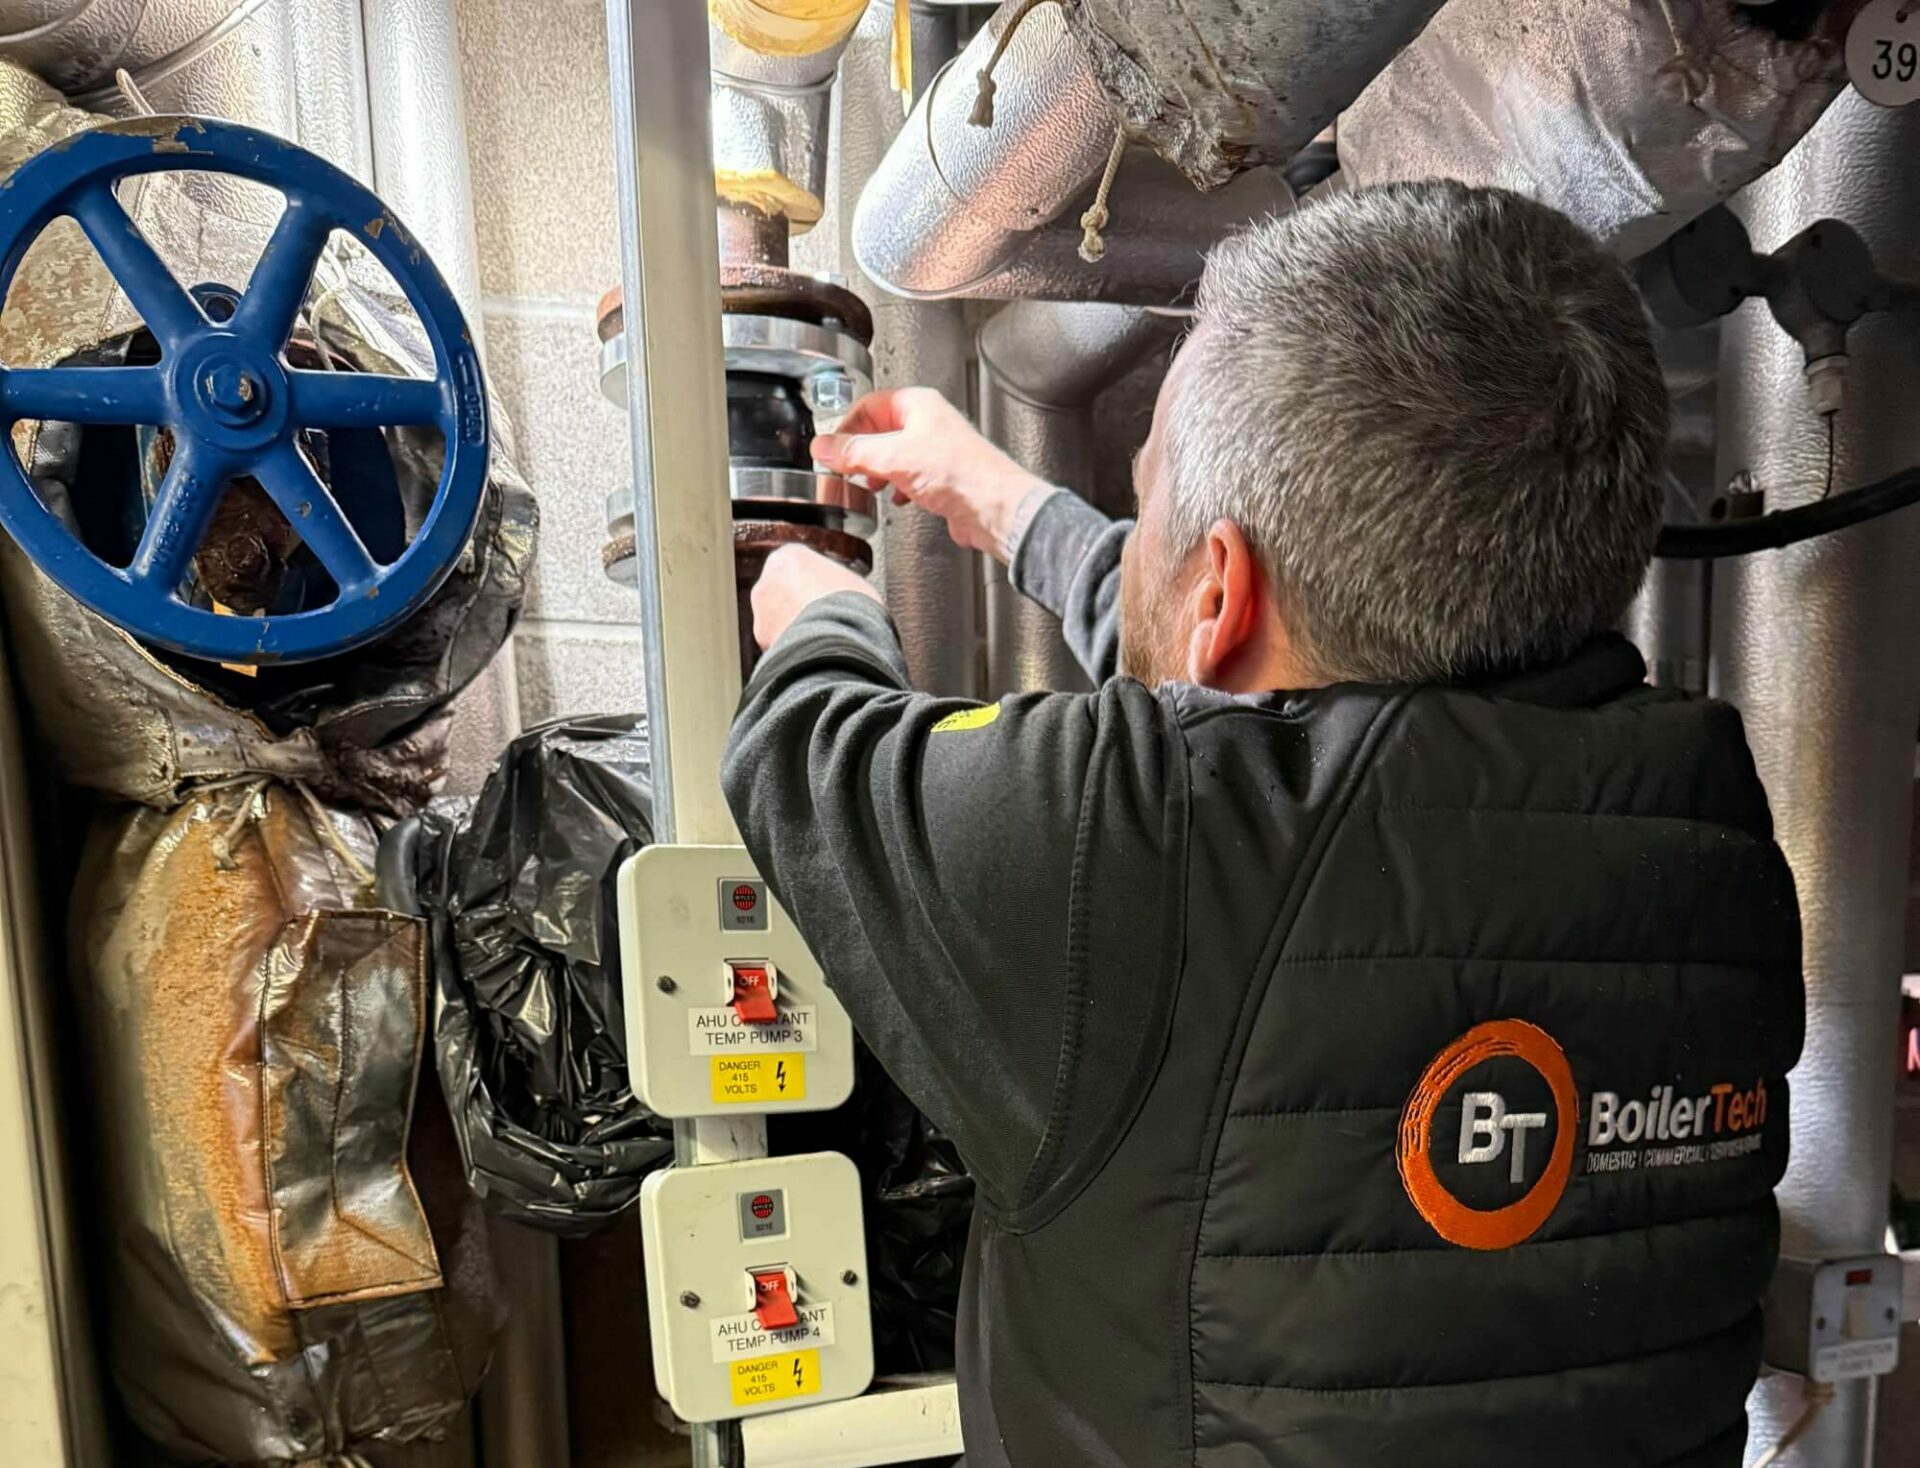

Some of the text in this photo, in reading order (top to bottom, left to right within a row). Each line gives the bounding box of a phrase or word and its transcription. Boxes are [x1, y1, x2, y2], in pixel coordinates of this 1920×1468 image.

[1872, 40, 1917, 82] 39
[739, 975, 760, 987] OFF
[696, 1014, 727, 1028] AHU
[705, 1030, 803, 1045] TEMP PUMP 3
[719, 1060, 760, 1071] DANGER
[732, 1072, 749, 1082] 415
[725, 1084, 757, 1094] VOLTS
[1588, 1077, 1766, 1146] BoilerTech
[1459, 1091, 1546, 1184] BT
[1586, 1149, 1637, 1174] DOMESTIC
[760, 1280, 780, 1292] OFF
[718, 1322, 748, 1337] AHU
[727, 1327, 820, 1352] TEMP PUMP 4
[738, 1360, 778, 1375] DANGER
[750, 1374, 767, 1383] 415
[744, 1383, 775, 1396] VOLTS
